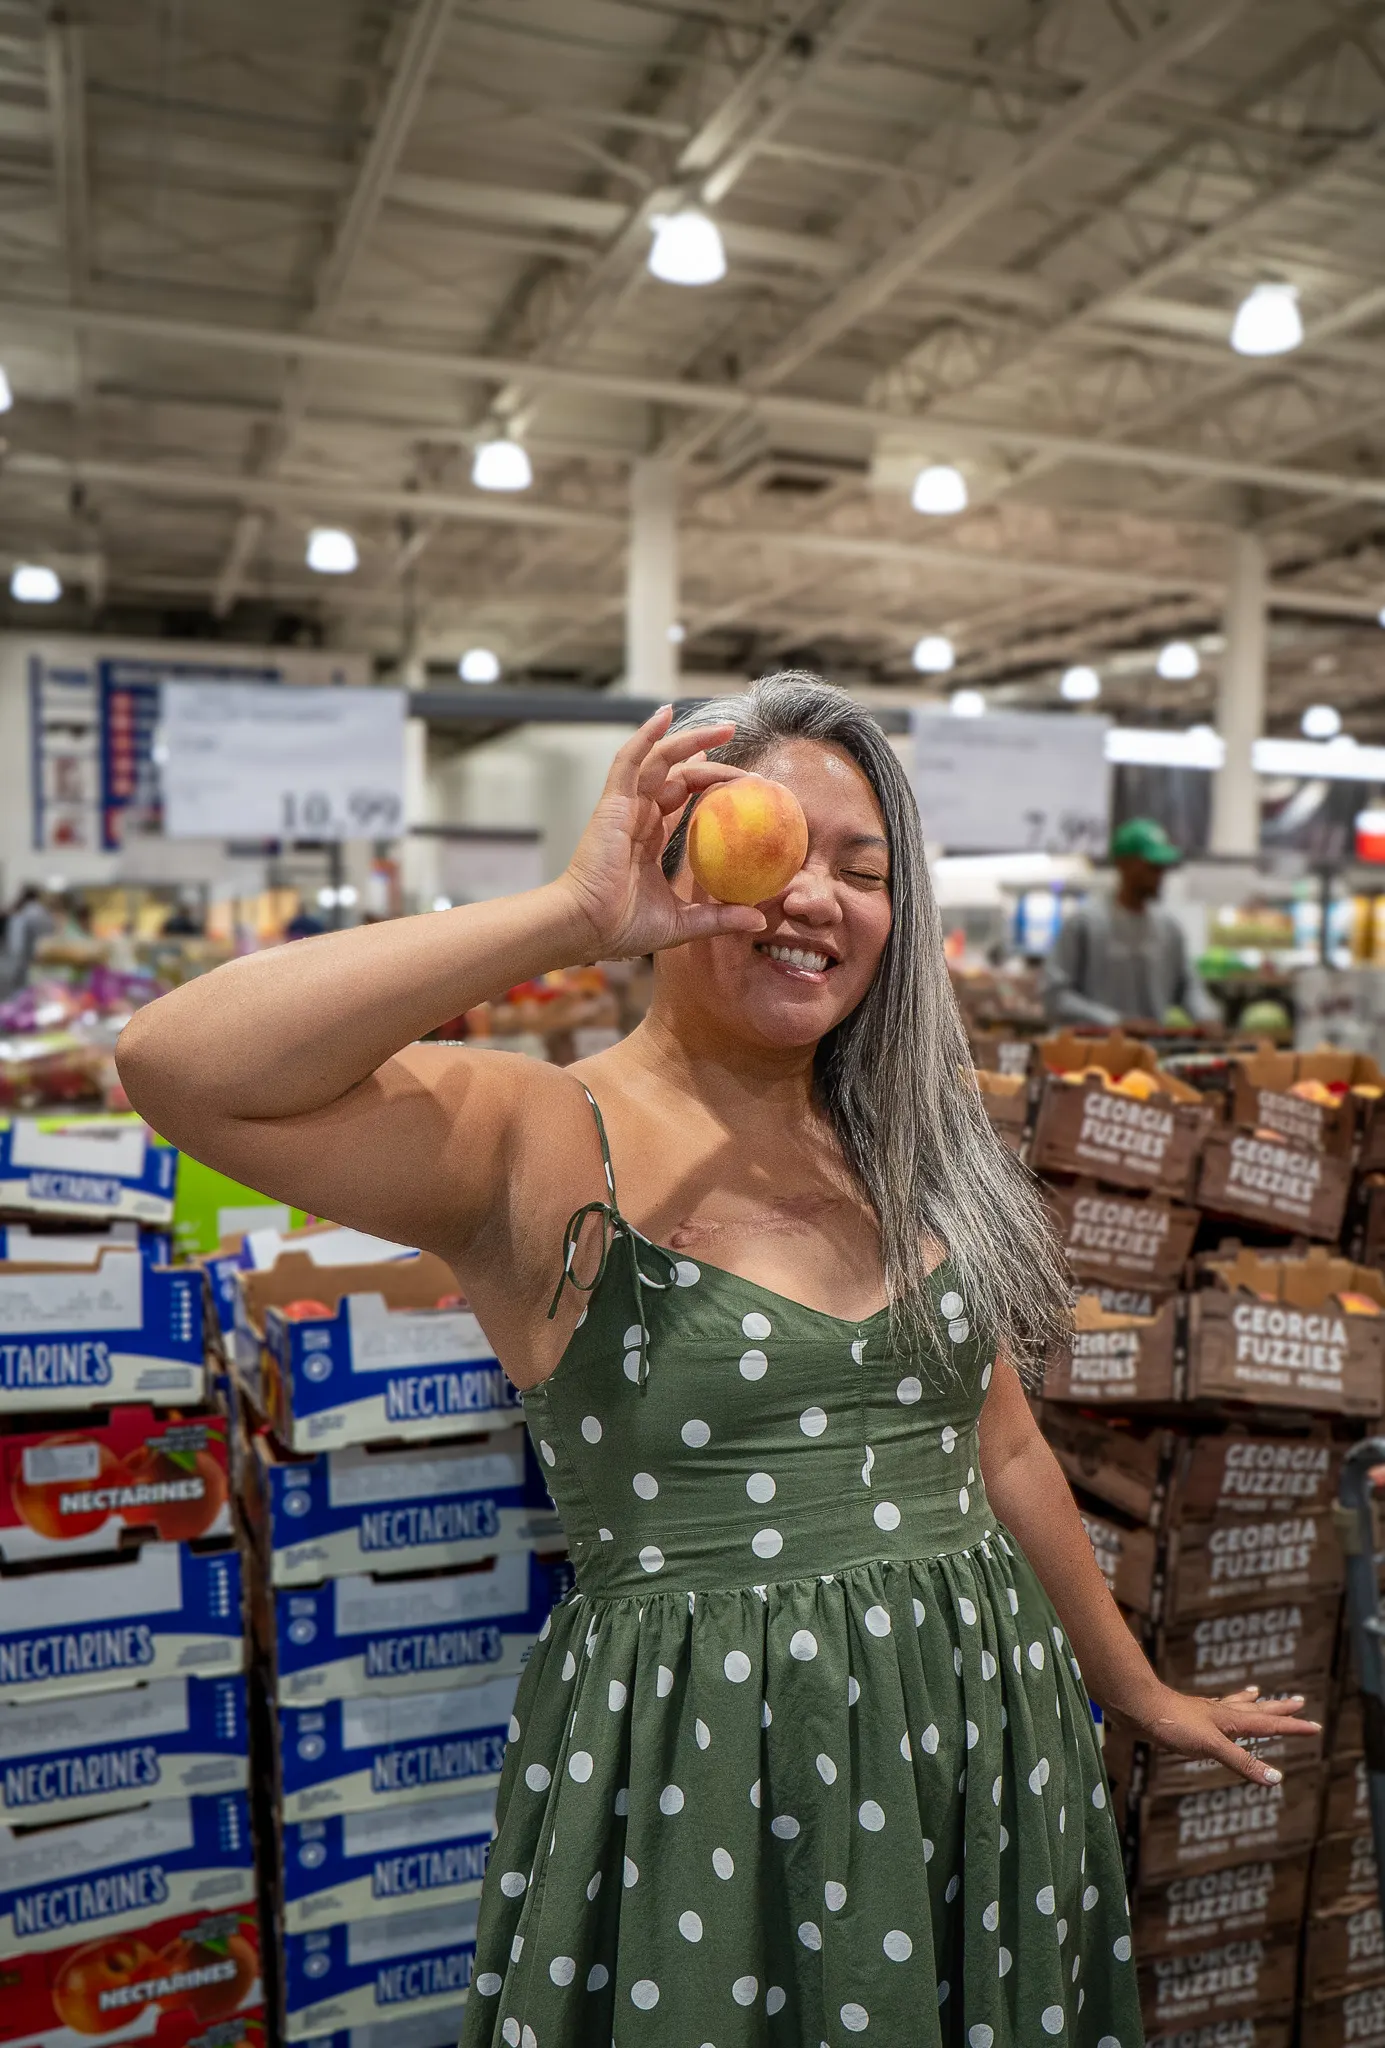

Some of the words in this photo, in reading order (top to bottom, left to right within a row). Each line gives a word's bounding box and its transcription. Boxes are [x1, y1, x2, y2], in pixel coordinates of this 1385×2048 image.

[1084, 1093, 1172, 1135] GEORGIA
[1081, 1119, 1165, 1158] FUZZIES
[1230, 1137, 1321, 1182] GEORGIA
[1229, 1160, 1314, 1202] FUZZIES
[1073, 1199, 1168, 1233] GEORGIA
[1070, 1222, 1160, 1256] FUZZIES
[1233, 1304, 1348, 1345] GEORGIA
[0, 1341, 109, 1387] TARINES
[1237, 1334, 1343, 1373] FUZZIES
[1225, 1443, 1330, 1470] GEORGIA
[60, 1478, 205, 1515] NECTARINES
[1221, 1470, 1321, 1495] FUZZIES
[363, 1499, 496, 1549] NECTARINES
[1209, 1518, 1317, 1554] GEORGIA
[1210, 1544, 1312, 1580] FUZZIES
[1194, 1606, 1303, 1643] GEORGIA
[0, 1625, 152, 1682] NECTARINES
[367, 1627, 500, 1677] NECTARINES
[1196, 1632, 1297, 1669] FUZZIES
[5, 1746, 158, 1805] NECTARINES
[373, 1736, 504, 1791] NECTARINES
[1178, 1783, 1284, 1818] GEORGIA
[1179, 1804, 1278, 1844] FUZZIES
[374, 1842, 490, 1895] NECTARINE
[1166, 1863, 1274, 1899] GEORGIA
[14, 1865, 167, 1936] NECTARINES
[1167, 1887, 1268, 1927] FUZZIES
[100, 1959, 238, 2011] NECTARINES
[1157, 1962, 1259, 2003] FUZZIES
